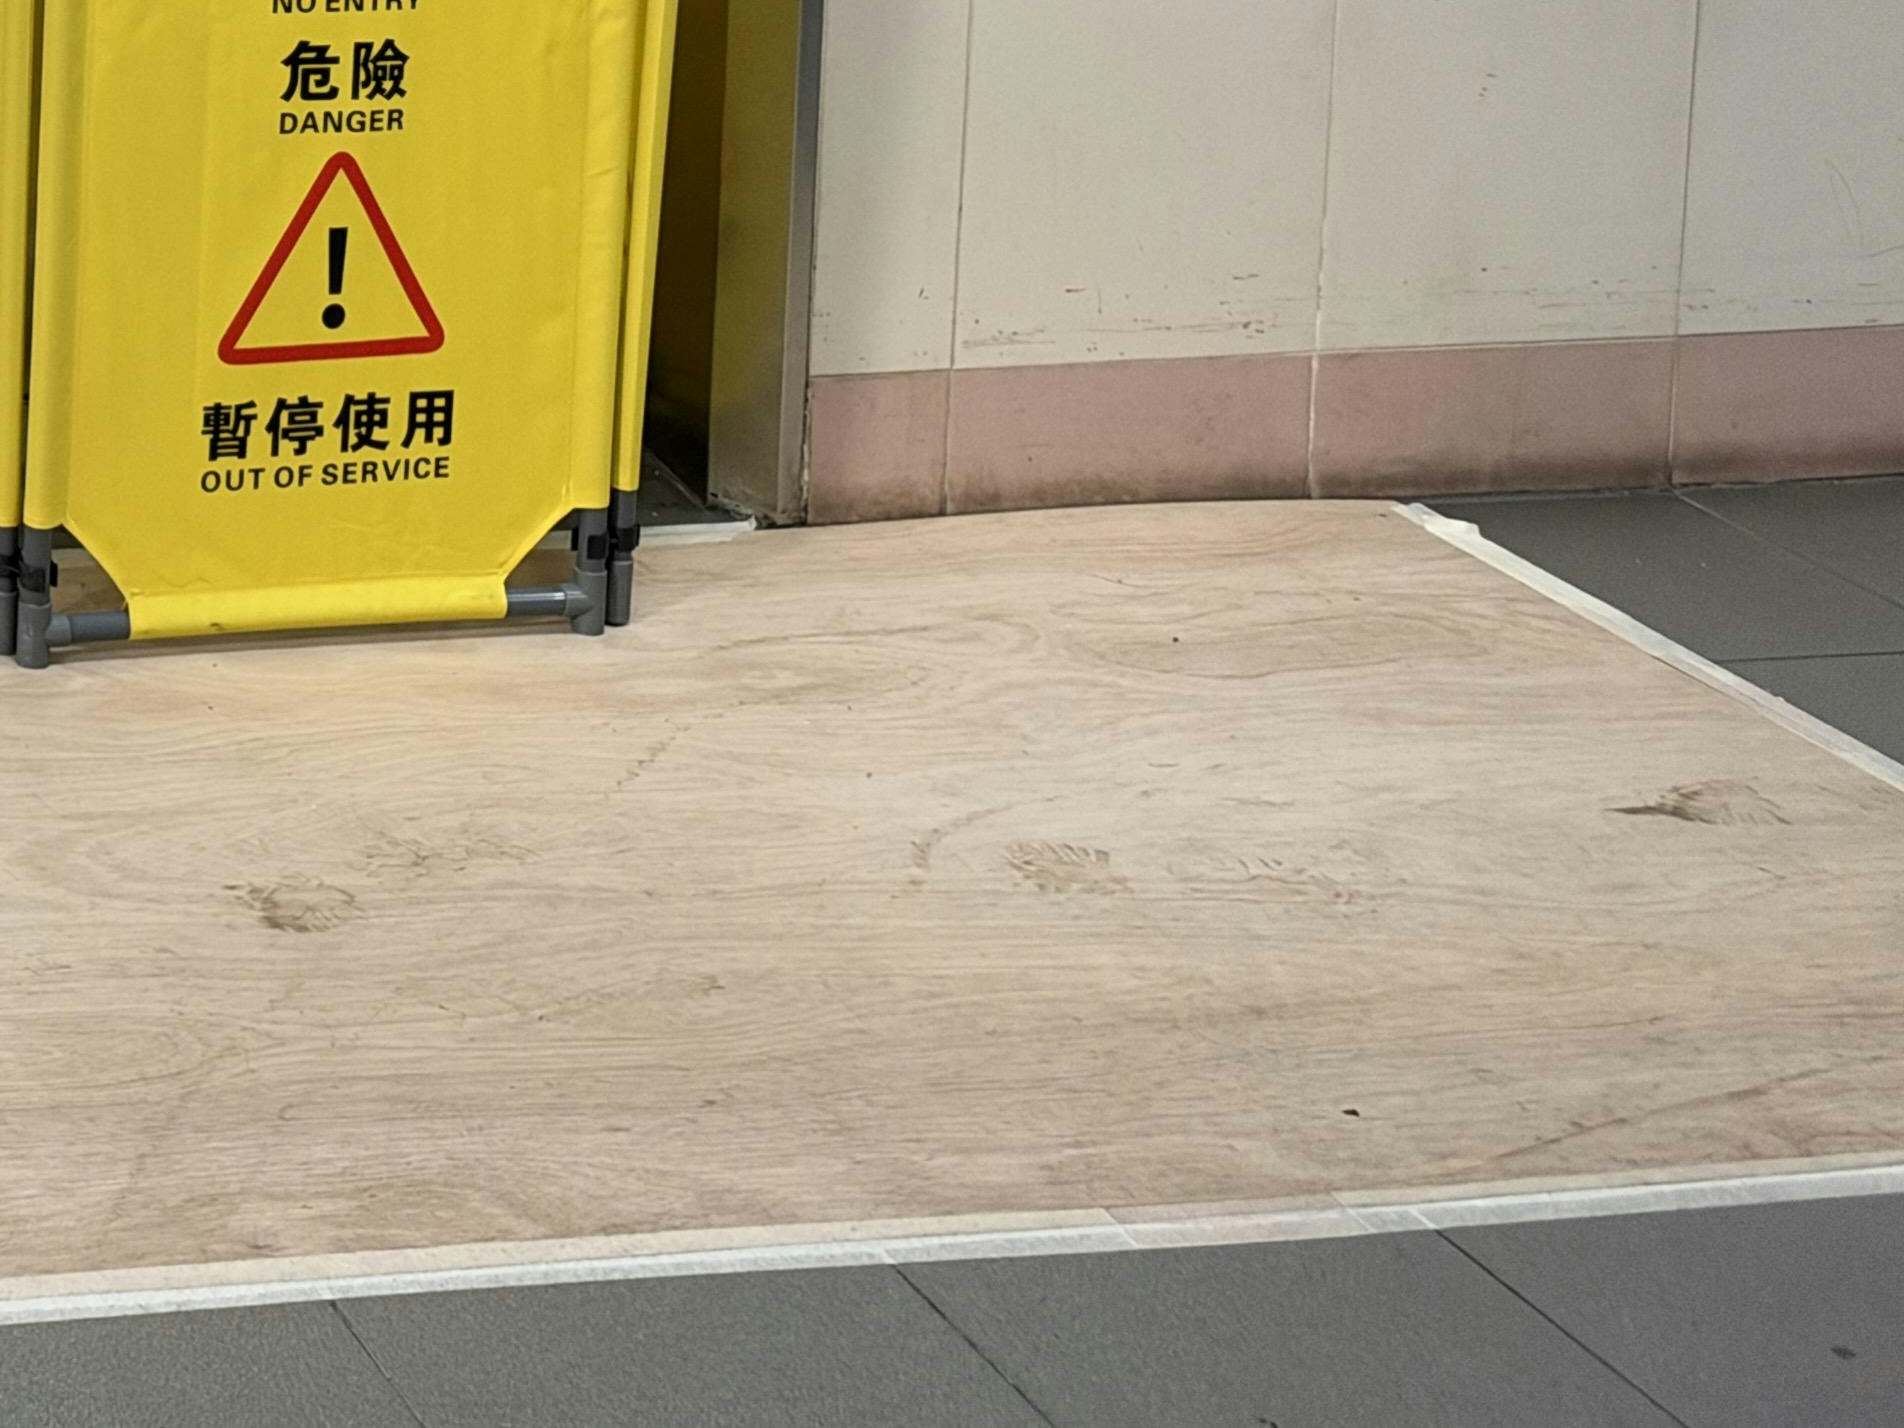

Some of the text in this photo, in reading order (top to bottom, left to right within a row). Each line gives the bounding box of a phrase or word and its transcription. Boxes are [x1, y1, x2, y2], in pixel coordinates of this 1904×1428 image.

[279, 37, 411, 103] 危險
[278, 107, 405, 136] DANGER
[200, 388, 456, 463] 暫停使用
[199, 456, 451, 494] OUT OF SERVICE
